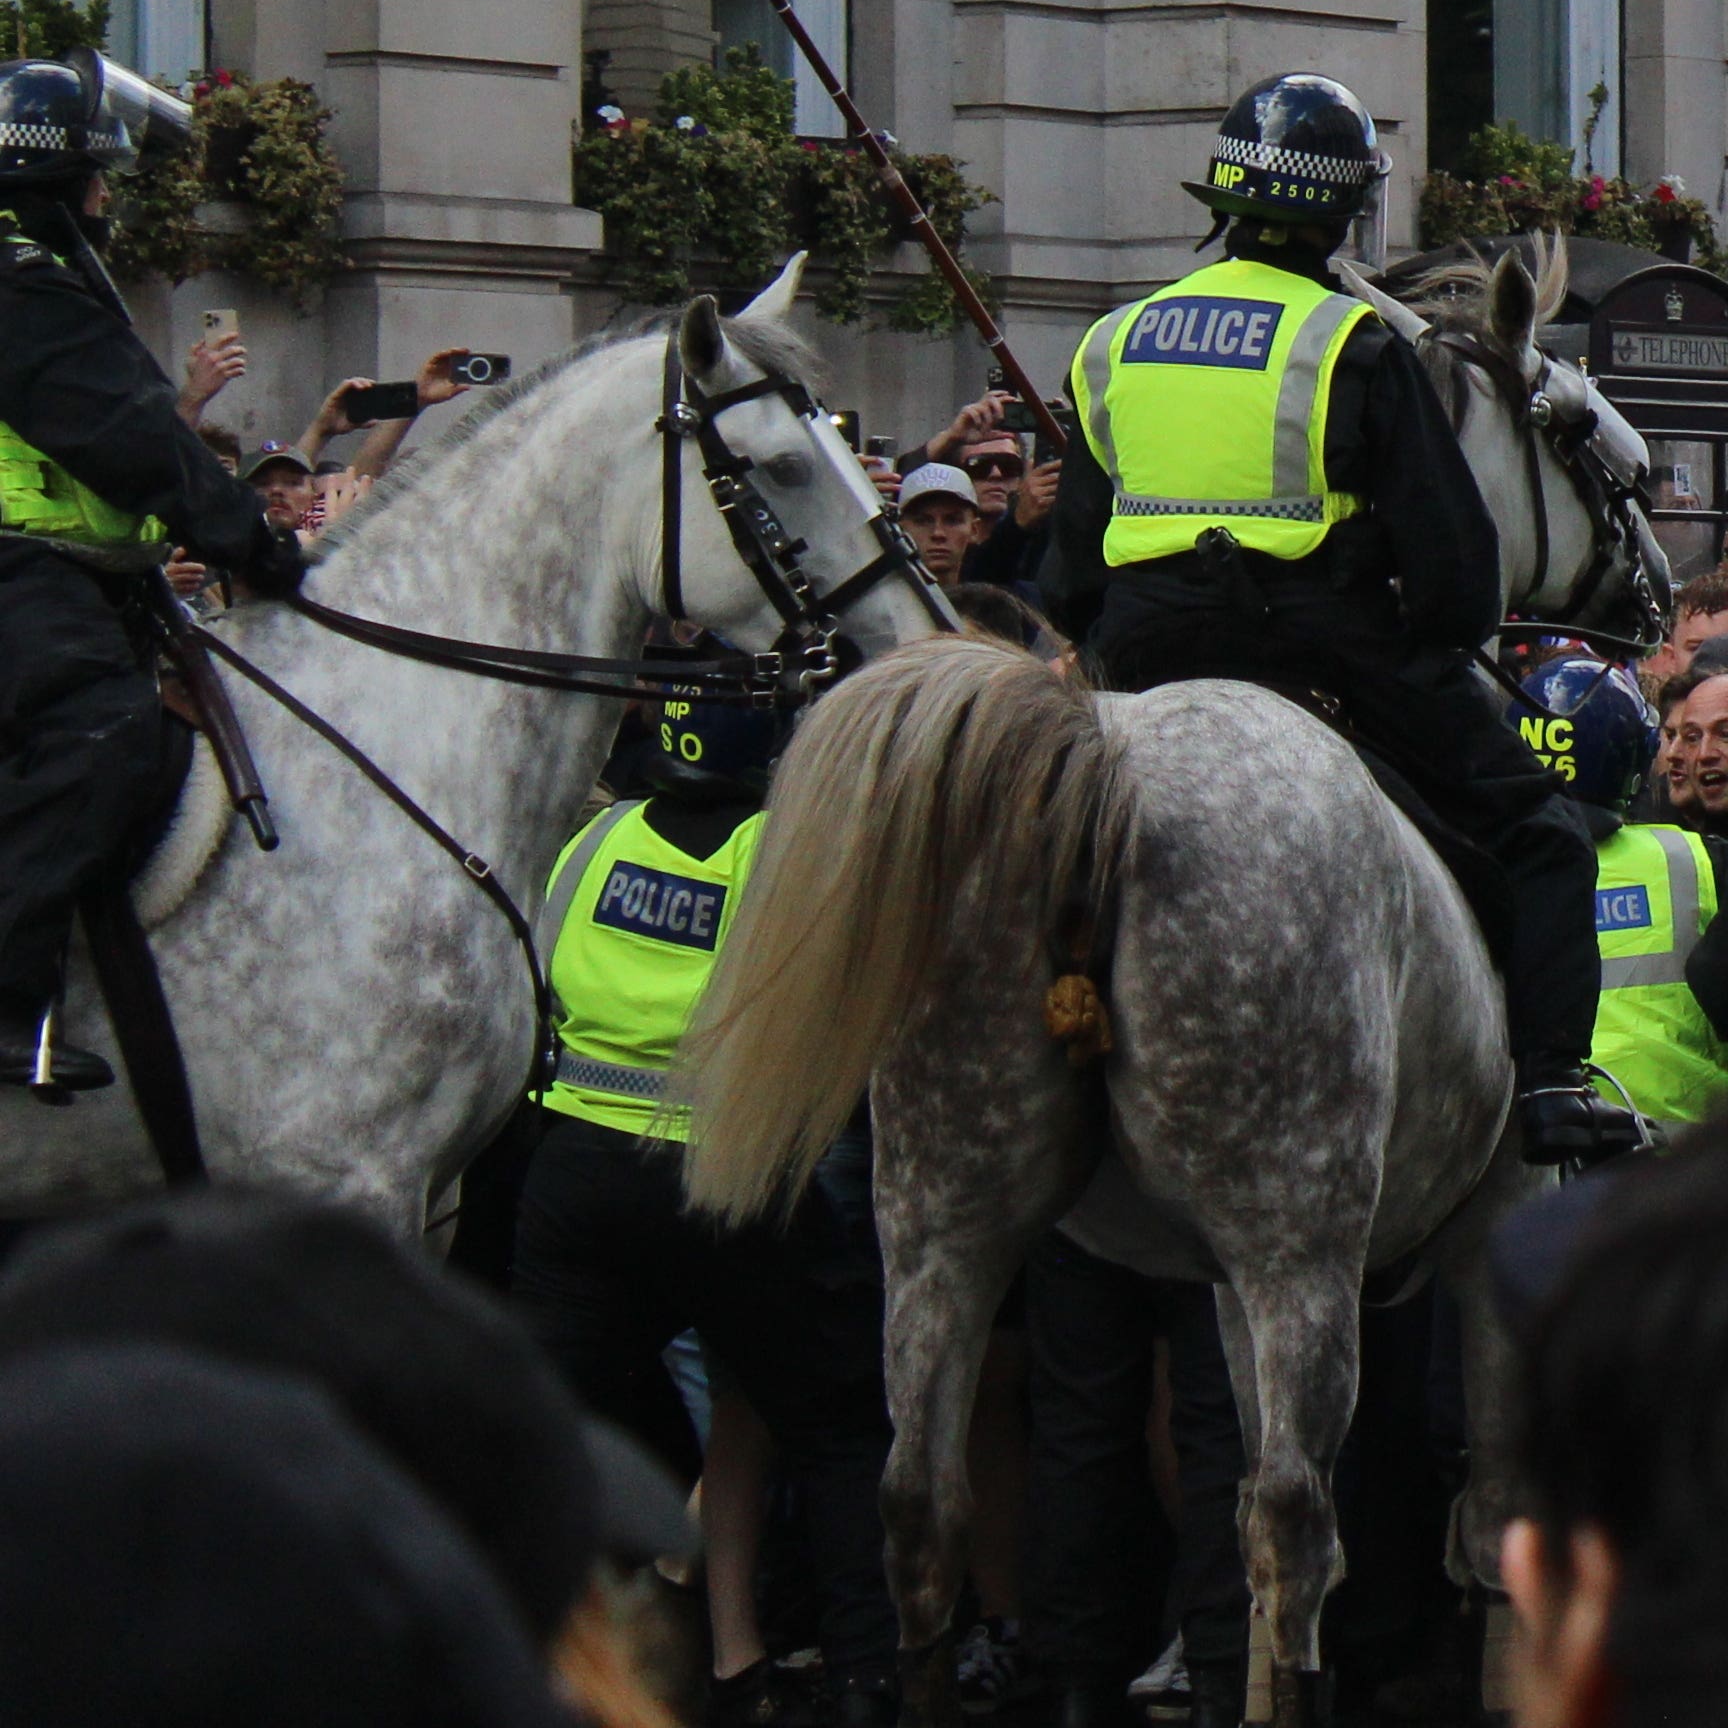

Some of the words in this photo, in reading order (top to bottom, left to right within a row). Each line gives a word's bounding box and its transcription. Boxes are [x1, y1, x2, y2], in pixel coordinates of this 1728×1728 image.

[1213, 161, 1245, 189] MP
[1270, 181, 1331, 203] 2502
[1129, 307, 1272, 357] POLICE
[664, 701, 690, 721] MP
[1520, 717, 1574, 751] NC
[601, 870, 716, 937] POLICE
